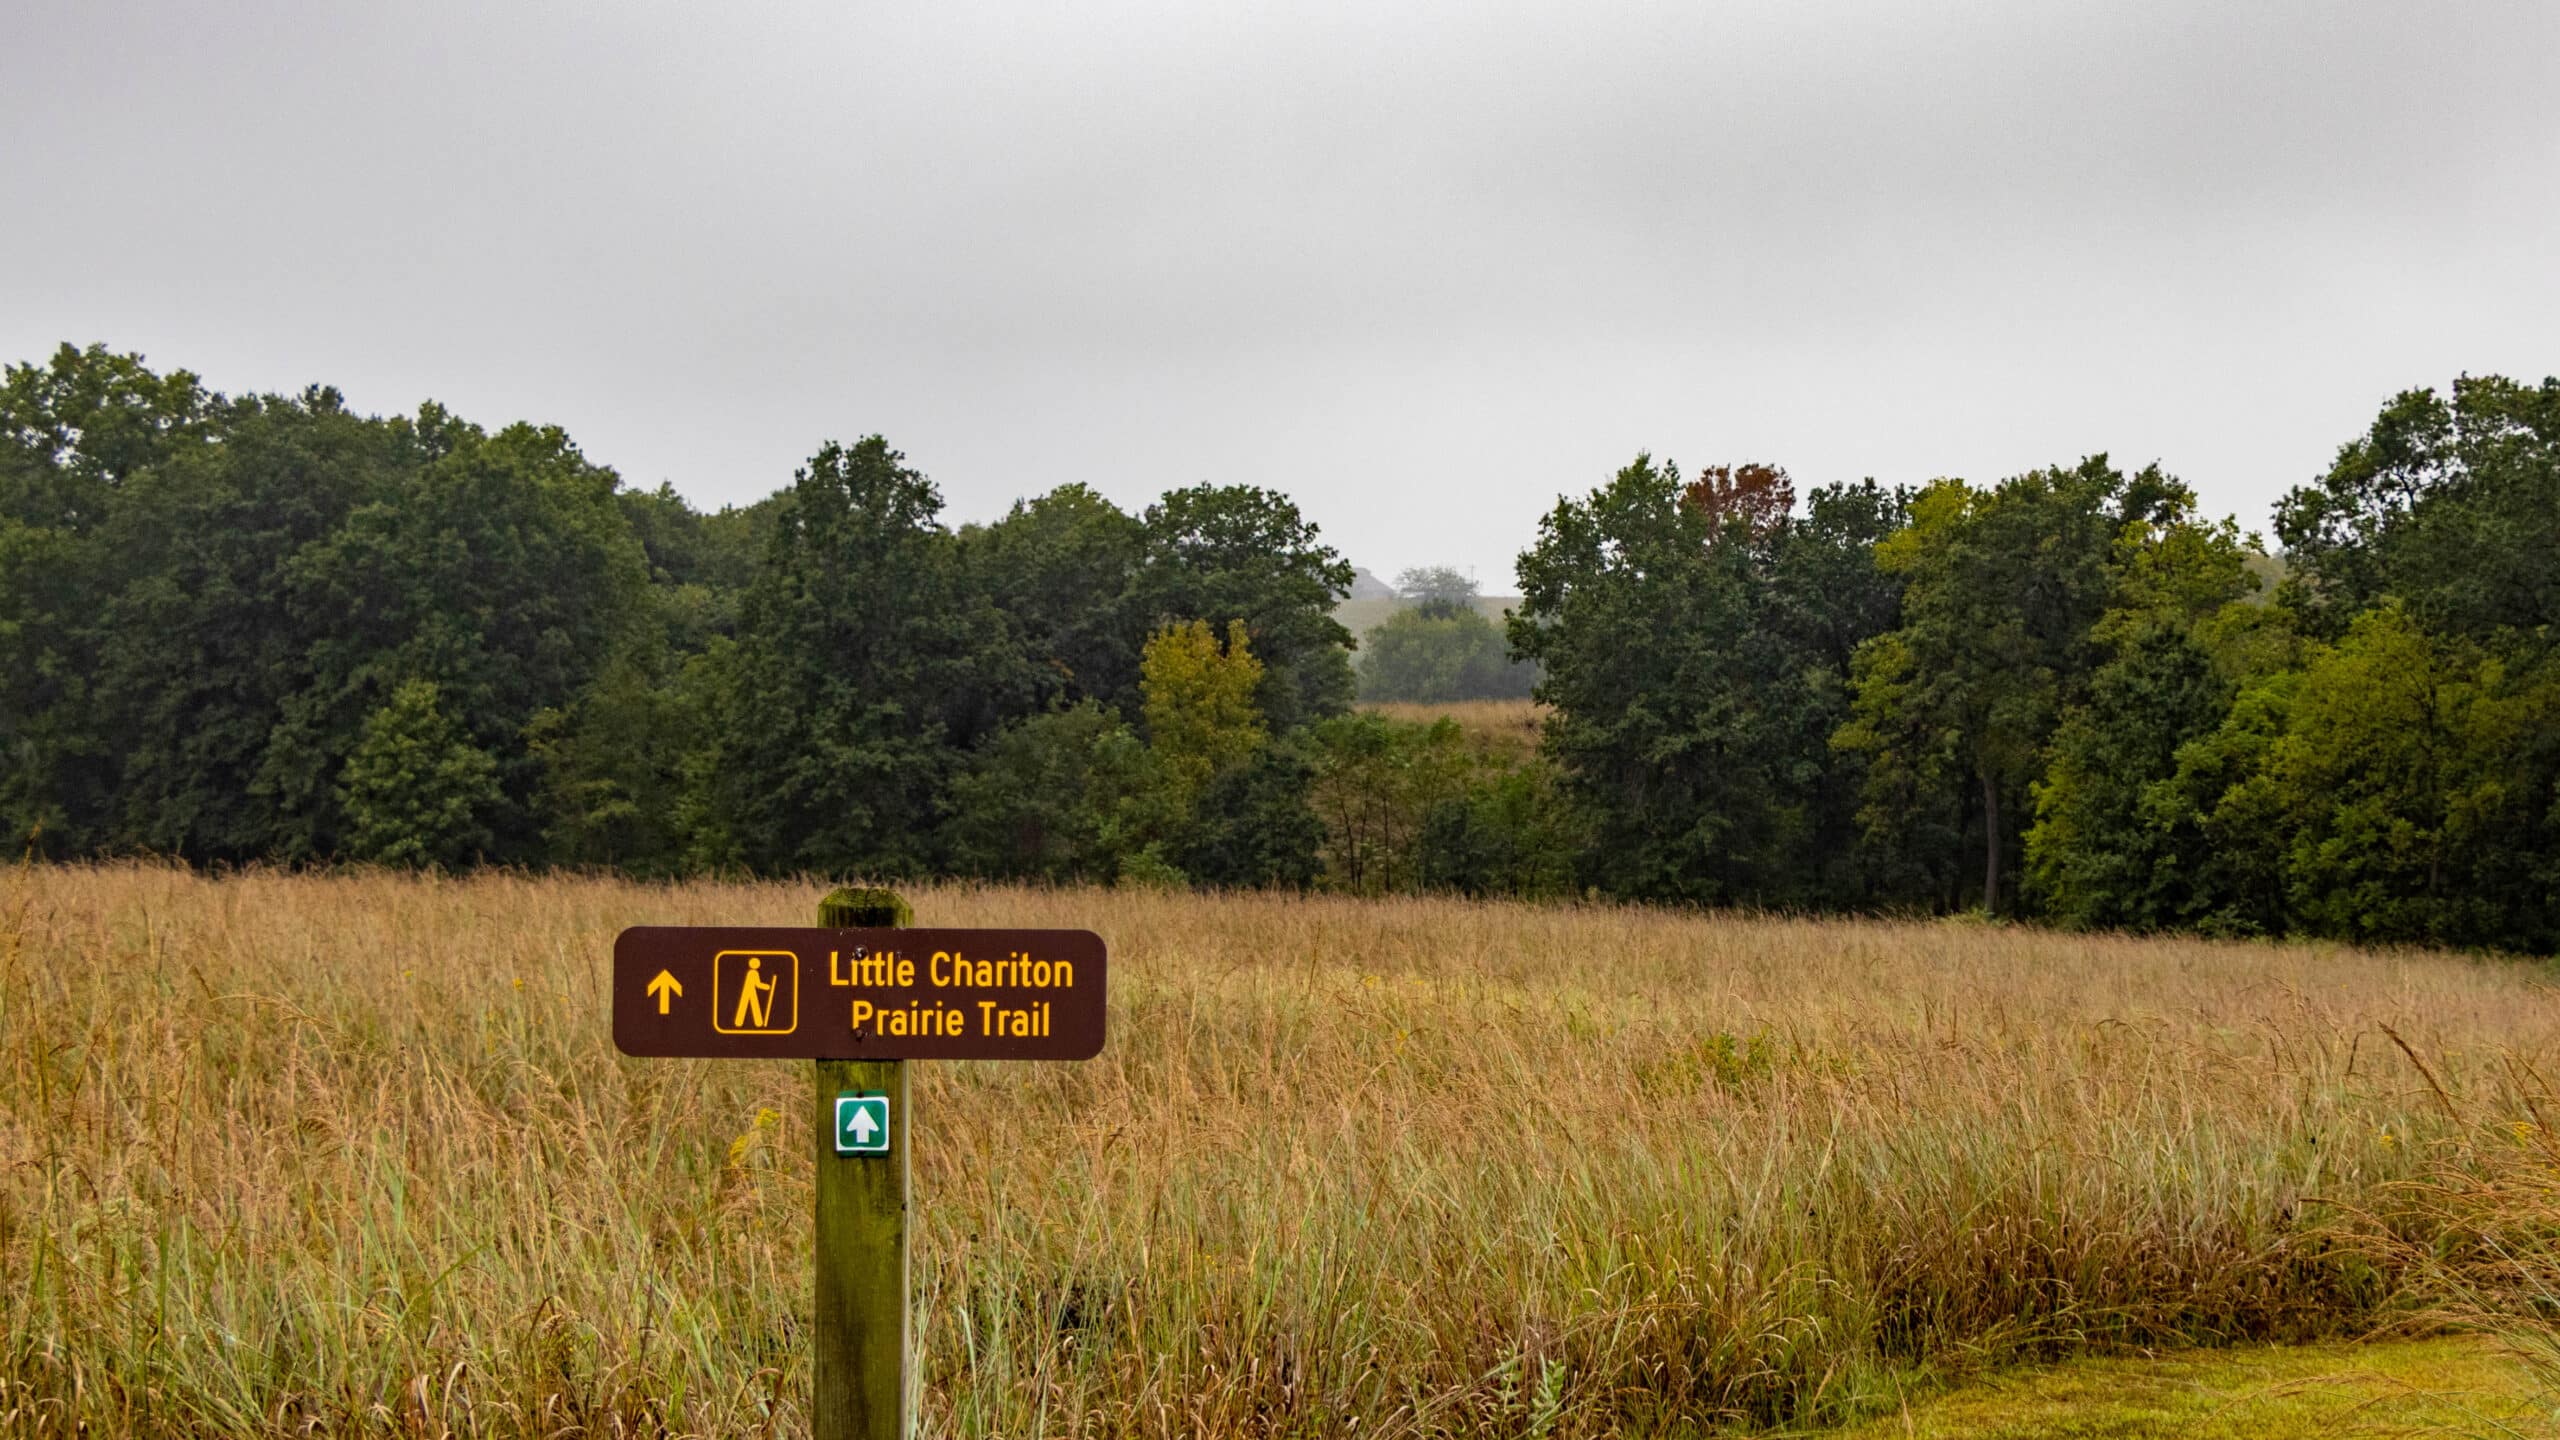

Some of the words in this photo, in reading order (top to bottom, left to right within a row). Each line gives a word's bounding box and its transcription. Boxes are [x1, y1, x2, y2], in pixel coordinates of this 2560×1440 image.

[830, 950, 915, 988] Little
[930, 951, 1074, 989] Chariton
[852, 1000, 966, 1037] Prairie
[977, 1001, 1050, 1038] Trail
